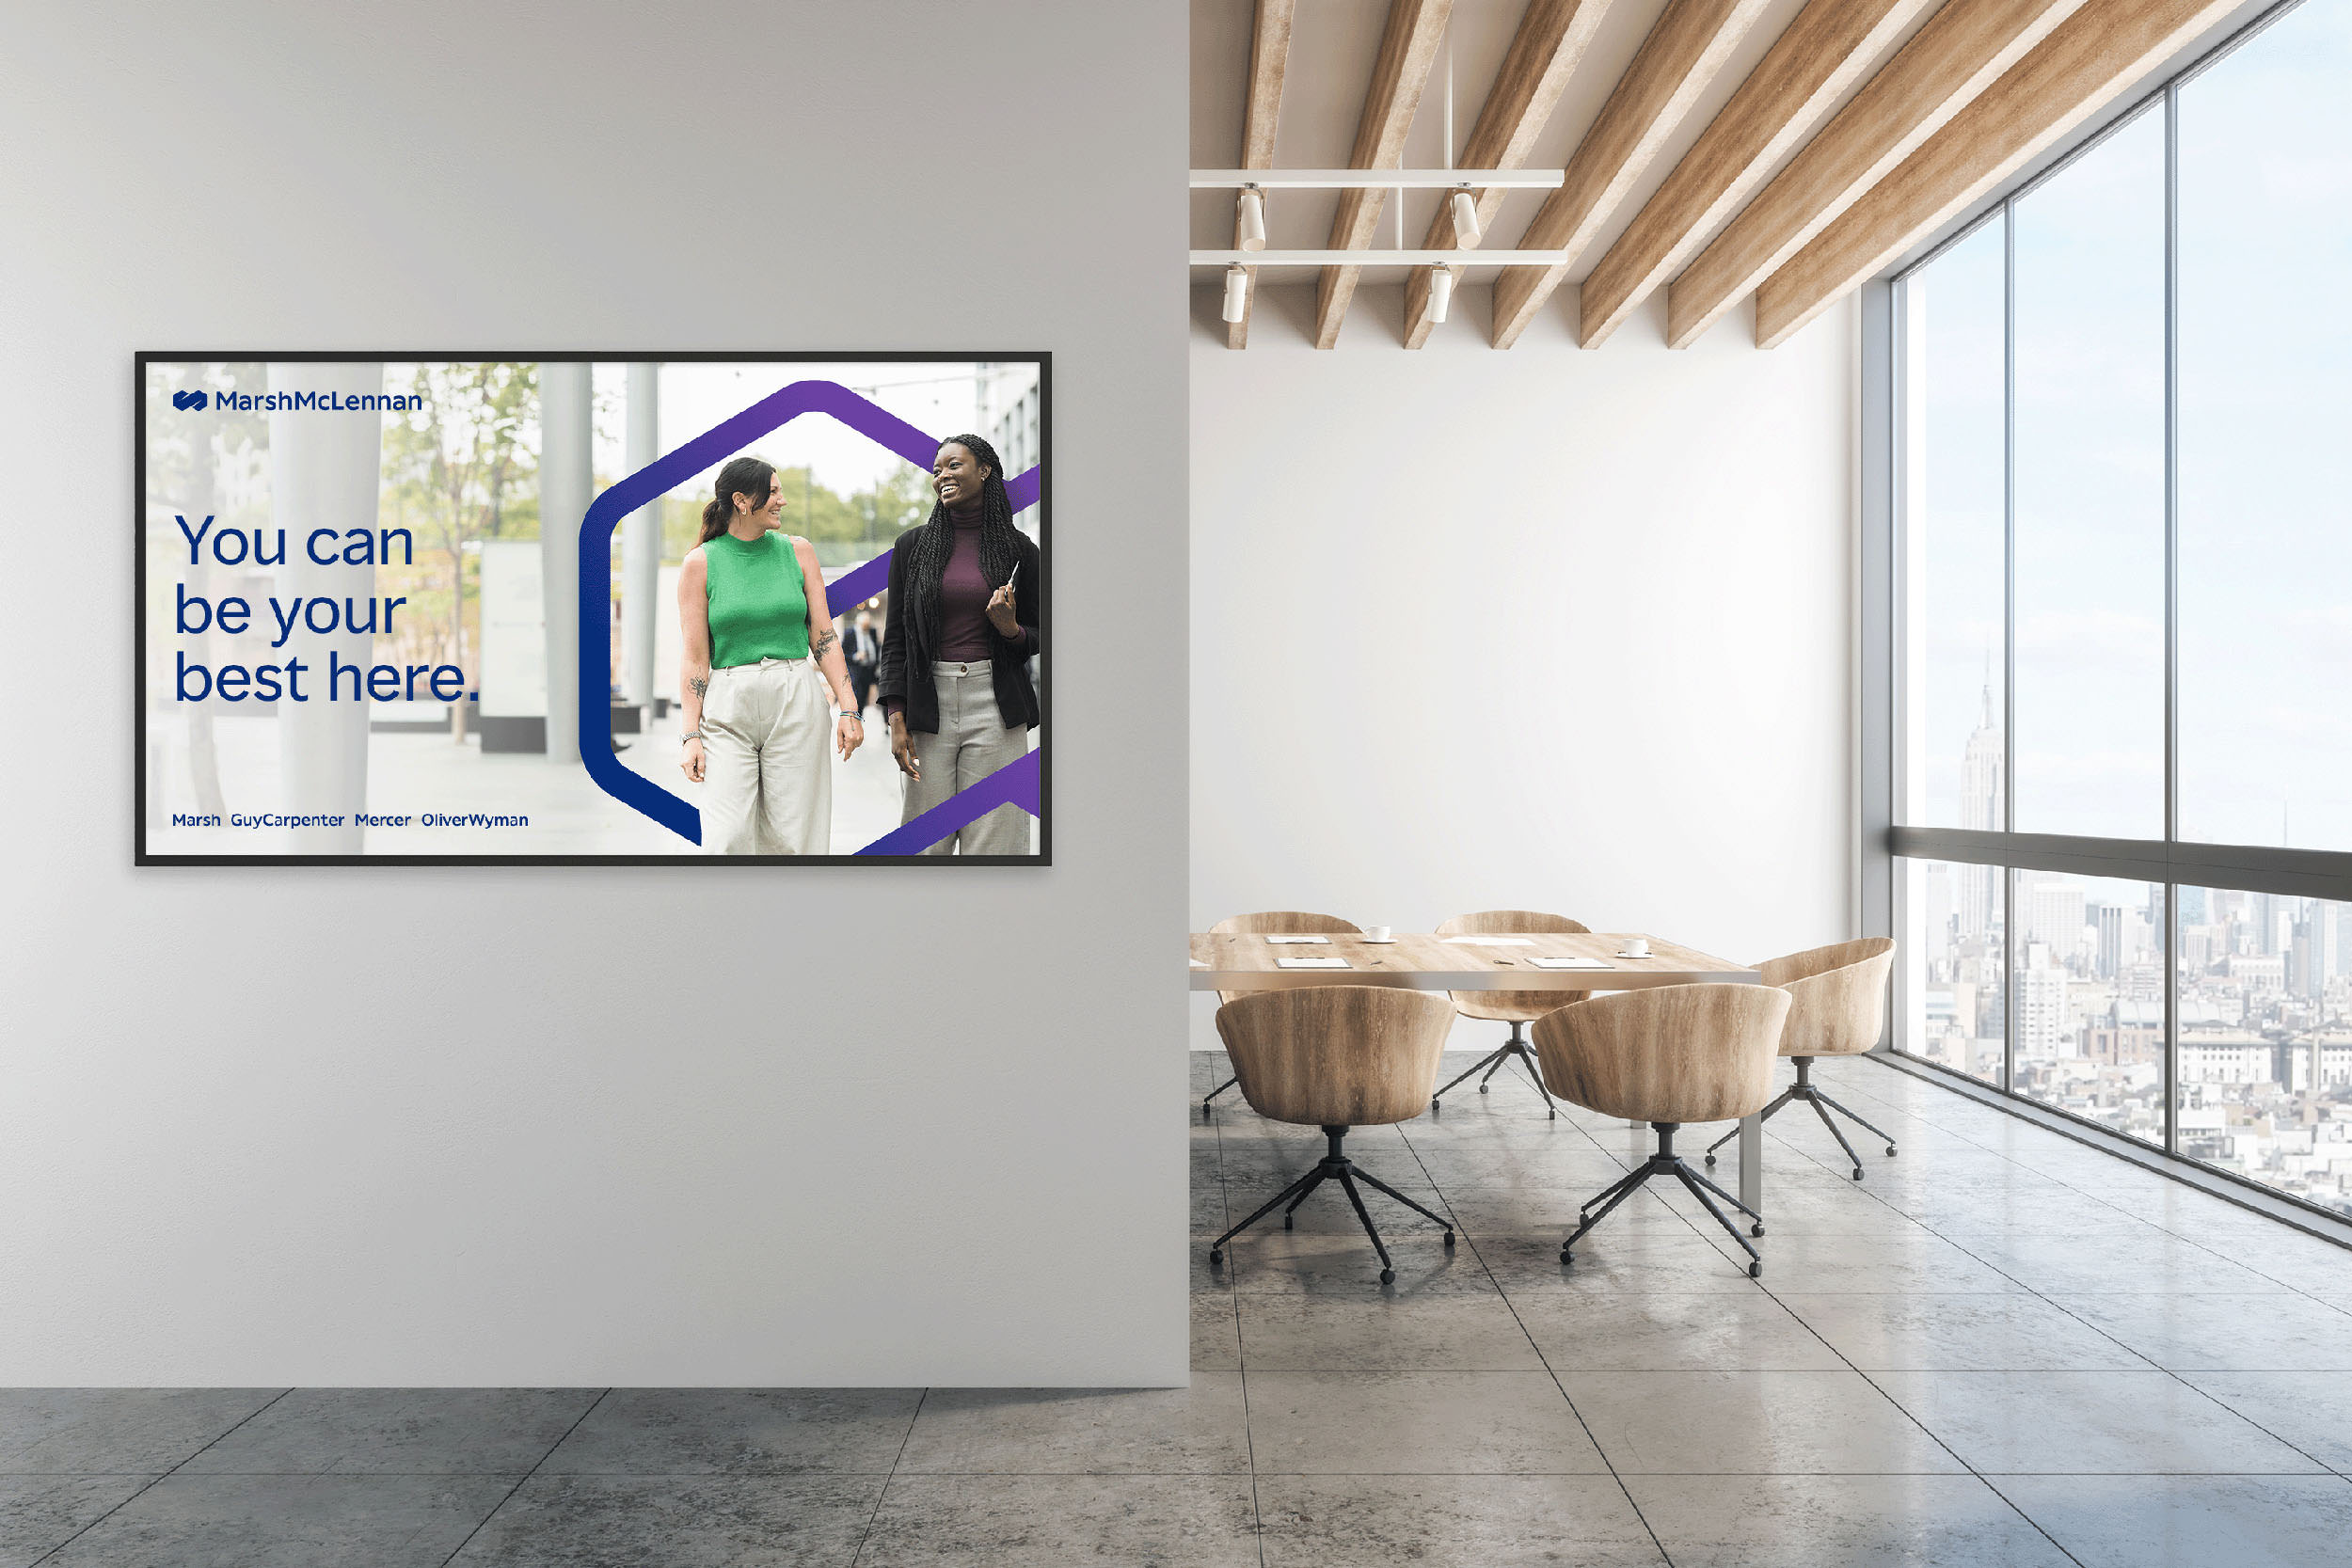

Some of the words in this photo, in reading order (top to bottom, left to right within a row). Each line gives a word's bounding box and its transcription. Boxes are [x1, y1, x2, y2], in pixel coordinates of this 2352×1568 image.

[215, 390, 422, 411] MarshMcLennan
[174, 515, 286, 566] You
[306, 528, 412, 566] can
[176, 582, 251, 635] be
[268, 596, 407, 648] your
[176, 650, 309, 703] best
[329, 650, 479, 703] here.
[172, 814, 221, 827] Marsh
[230, 814, 345, 830] GuyCarpenter
[355, 814, 412, 827] Mercer
[421, 813, 529, 830] OliverWyman
